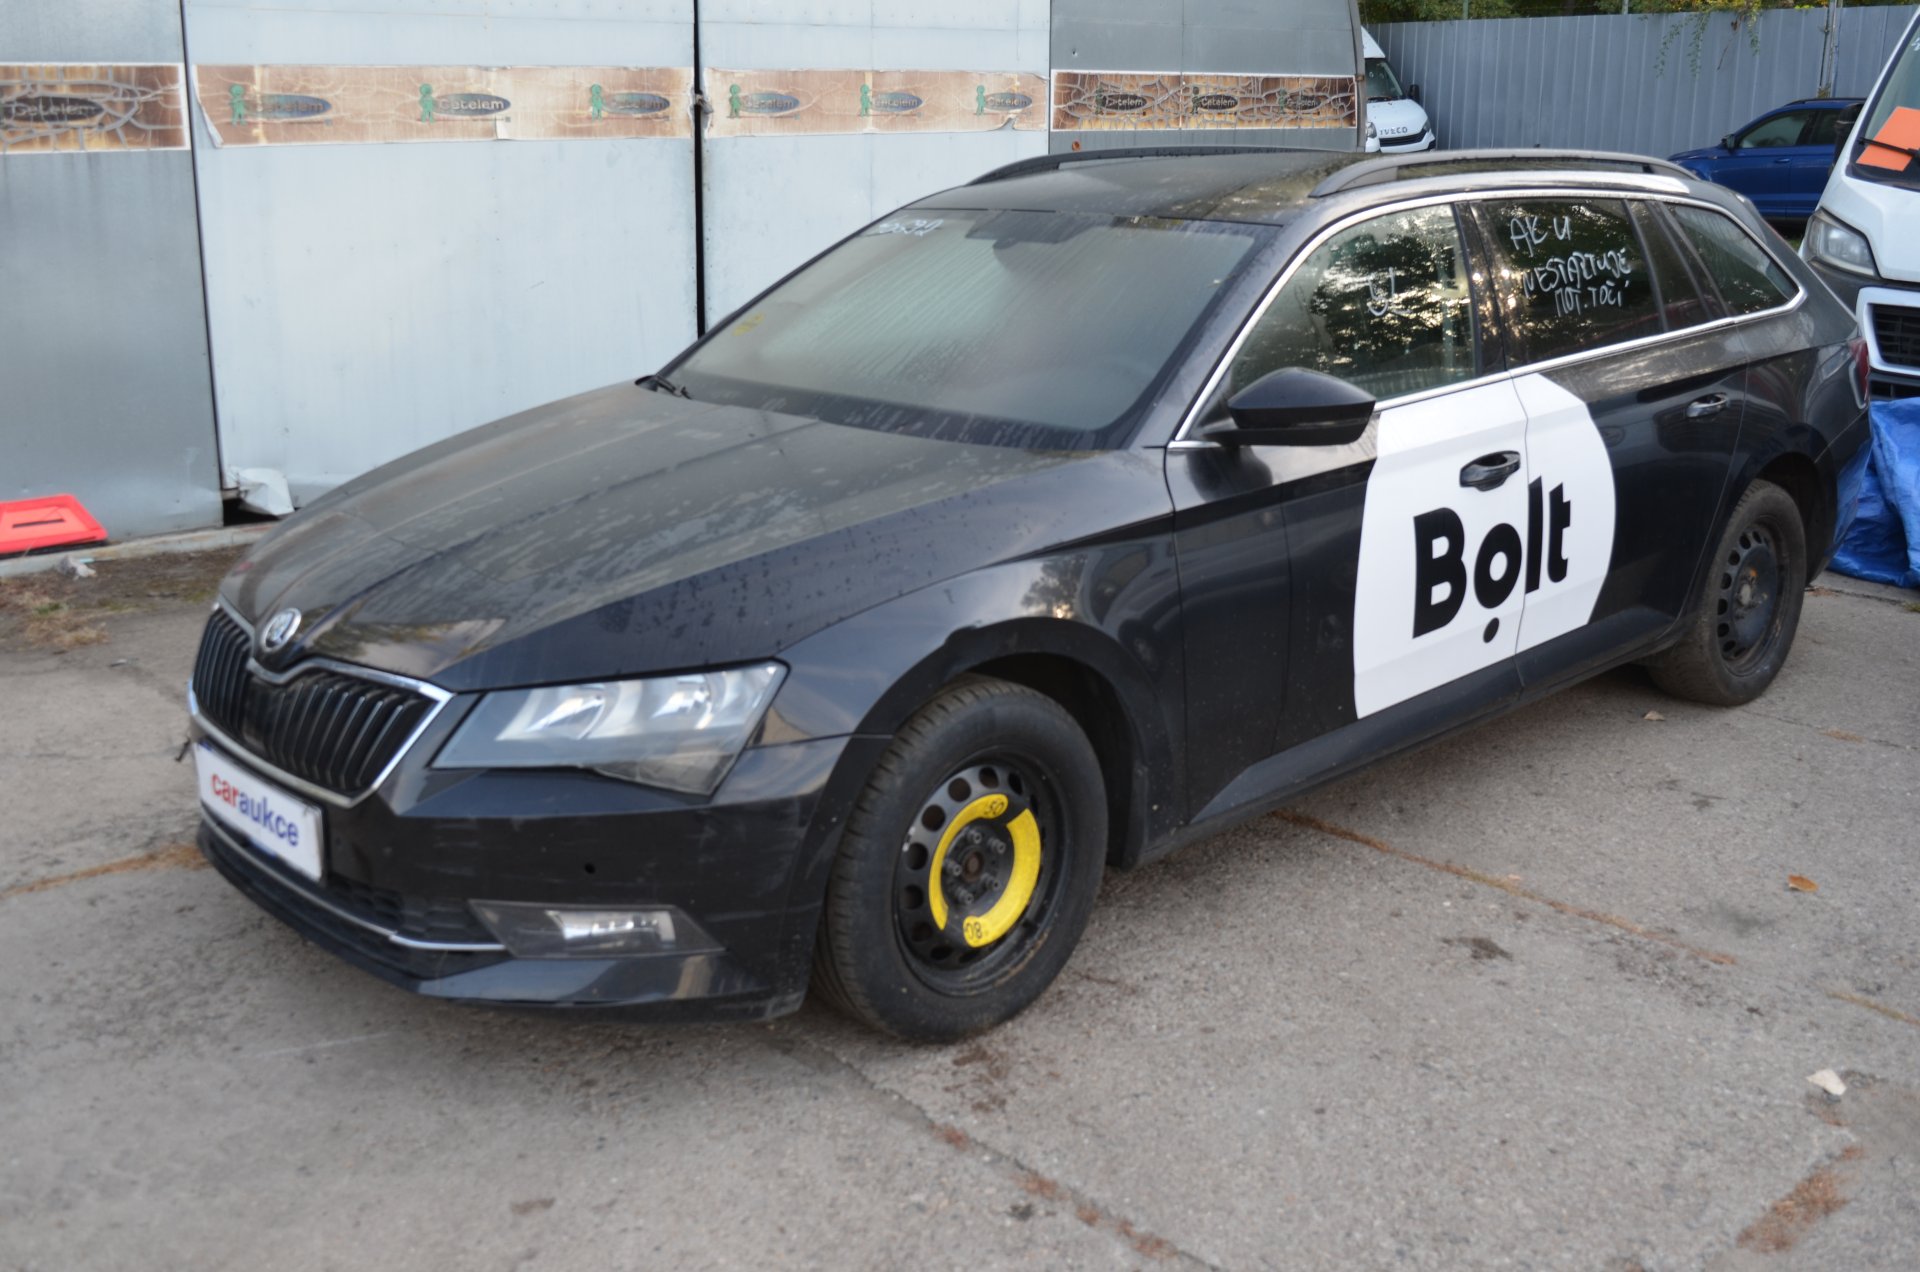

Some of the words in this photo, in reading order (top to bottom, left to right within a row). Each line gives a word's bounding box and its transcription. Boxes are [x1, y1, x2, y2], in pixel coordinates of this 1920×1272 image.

[1380, 126, 1408, 135] IVECO
[1412, 474, 1572, 643] Bolt
[211, 773, 300, 847] caraukce
